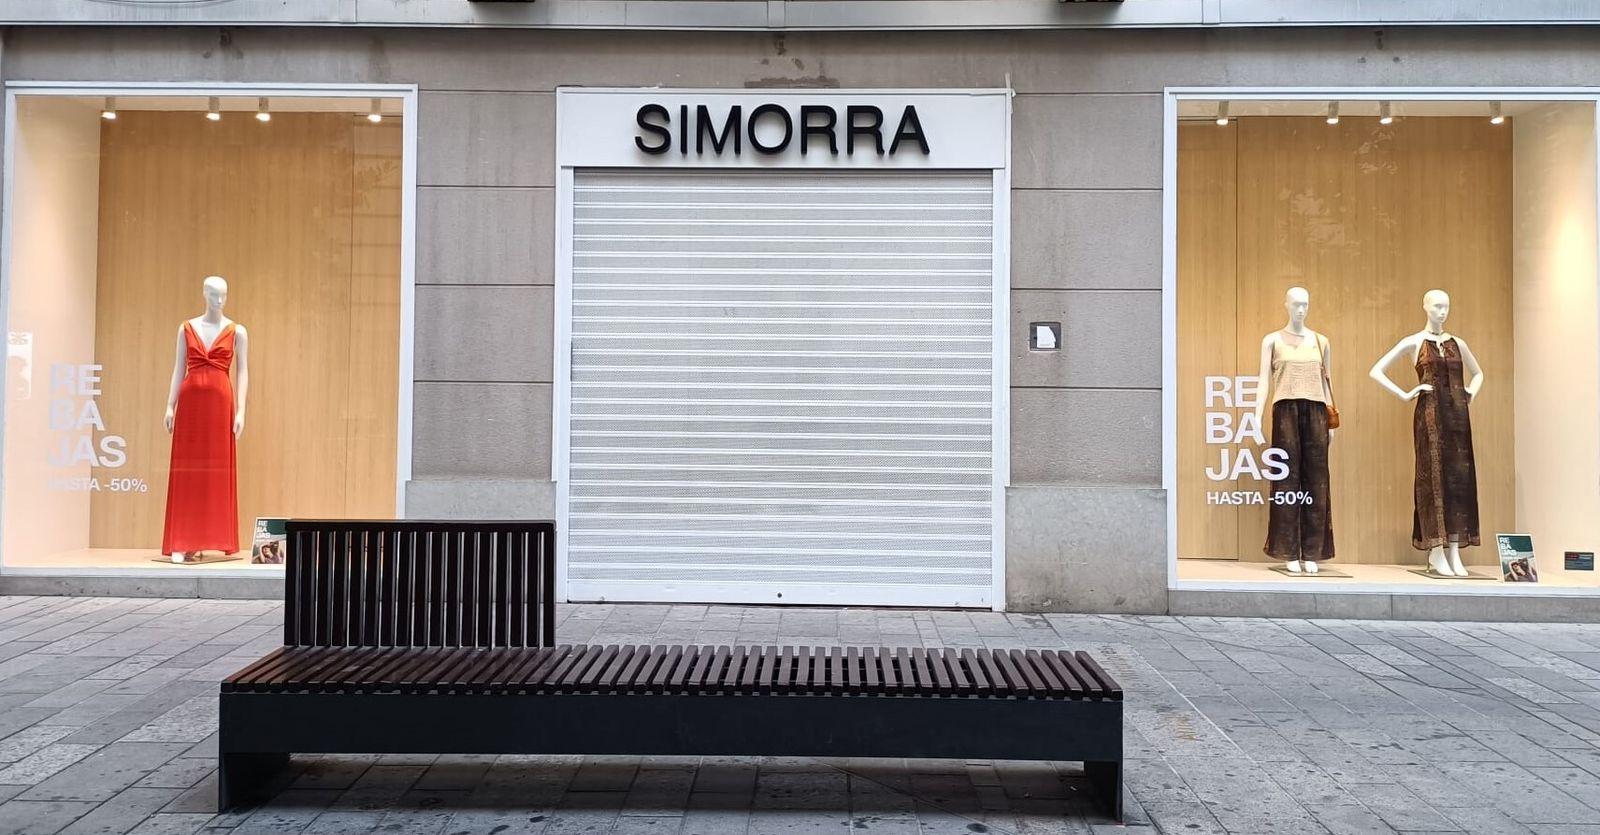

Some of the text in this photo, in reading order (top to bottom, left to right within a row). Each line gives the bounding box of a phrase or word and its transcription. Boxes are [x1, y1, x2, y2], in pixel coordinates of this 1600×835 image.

[634, 104, 930, 156] SIMORRA
[49, 363, 103, 395] RE
[1204, 376, 1262, 408] RE
[49, 399, 105, 432] BA
[1205, 412, 1266, 444] BA
[48, 435, 127, 468] JAS
[1205, 448, 1290, 481] JAS
[104, 478, 148, 493] -50%
[1206, 491, 1313, 505] HASTA -50%
